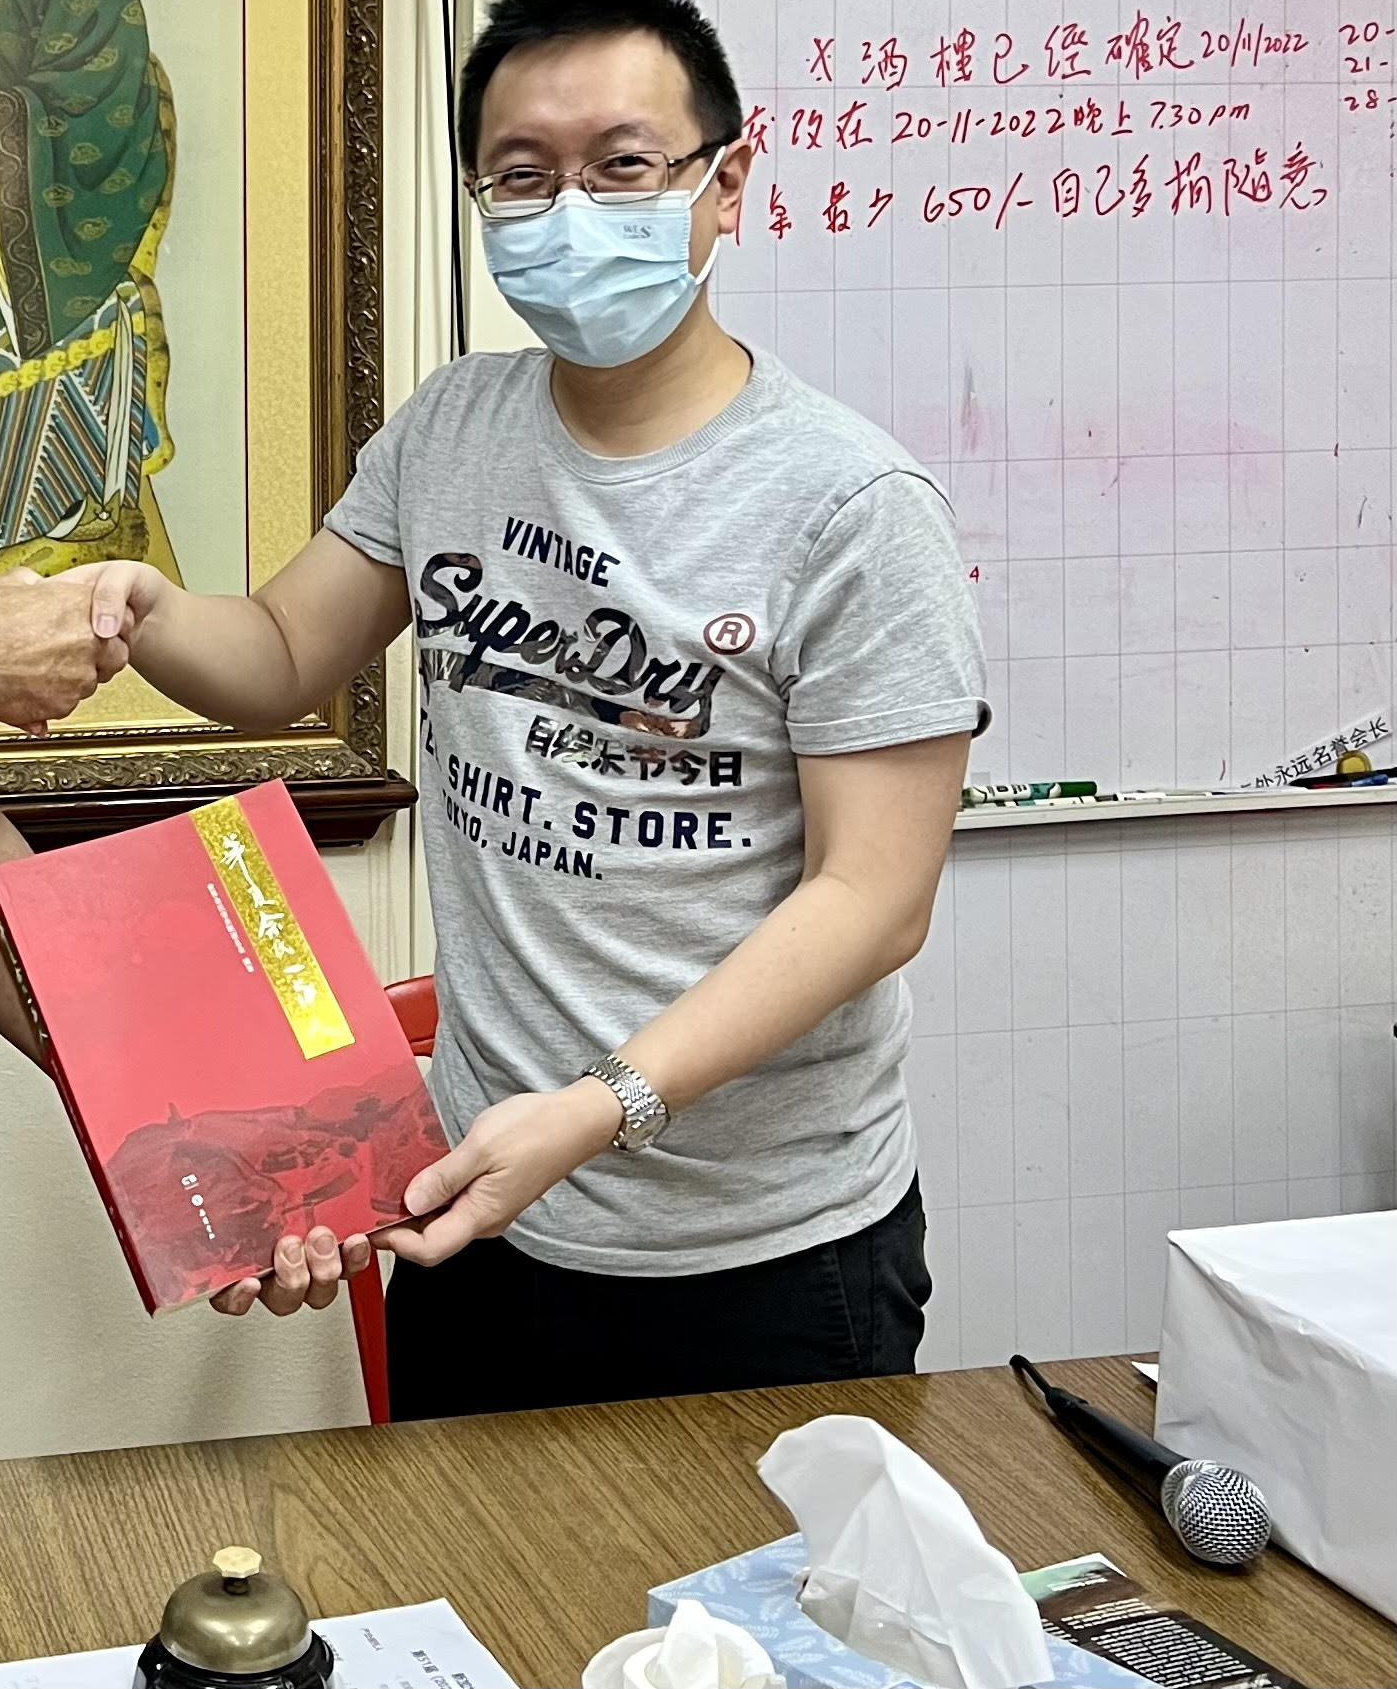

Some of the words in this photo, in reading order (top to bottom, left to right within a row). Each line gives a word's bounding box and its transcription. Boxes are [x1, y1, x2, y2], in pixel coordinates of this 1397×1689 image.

[891, 108, 1065, 144] 20-11-2022
[1073, 97, 1133, 136] 晚上
[502, 516, 621, 588] VINTAGE
[448, 754, 553, 831] SHIRT.
[572, 801, 752, 849] STORE.
[501, 831, 603, 881] JAPAN.
